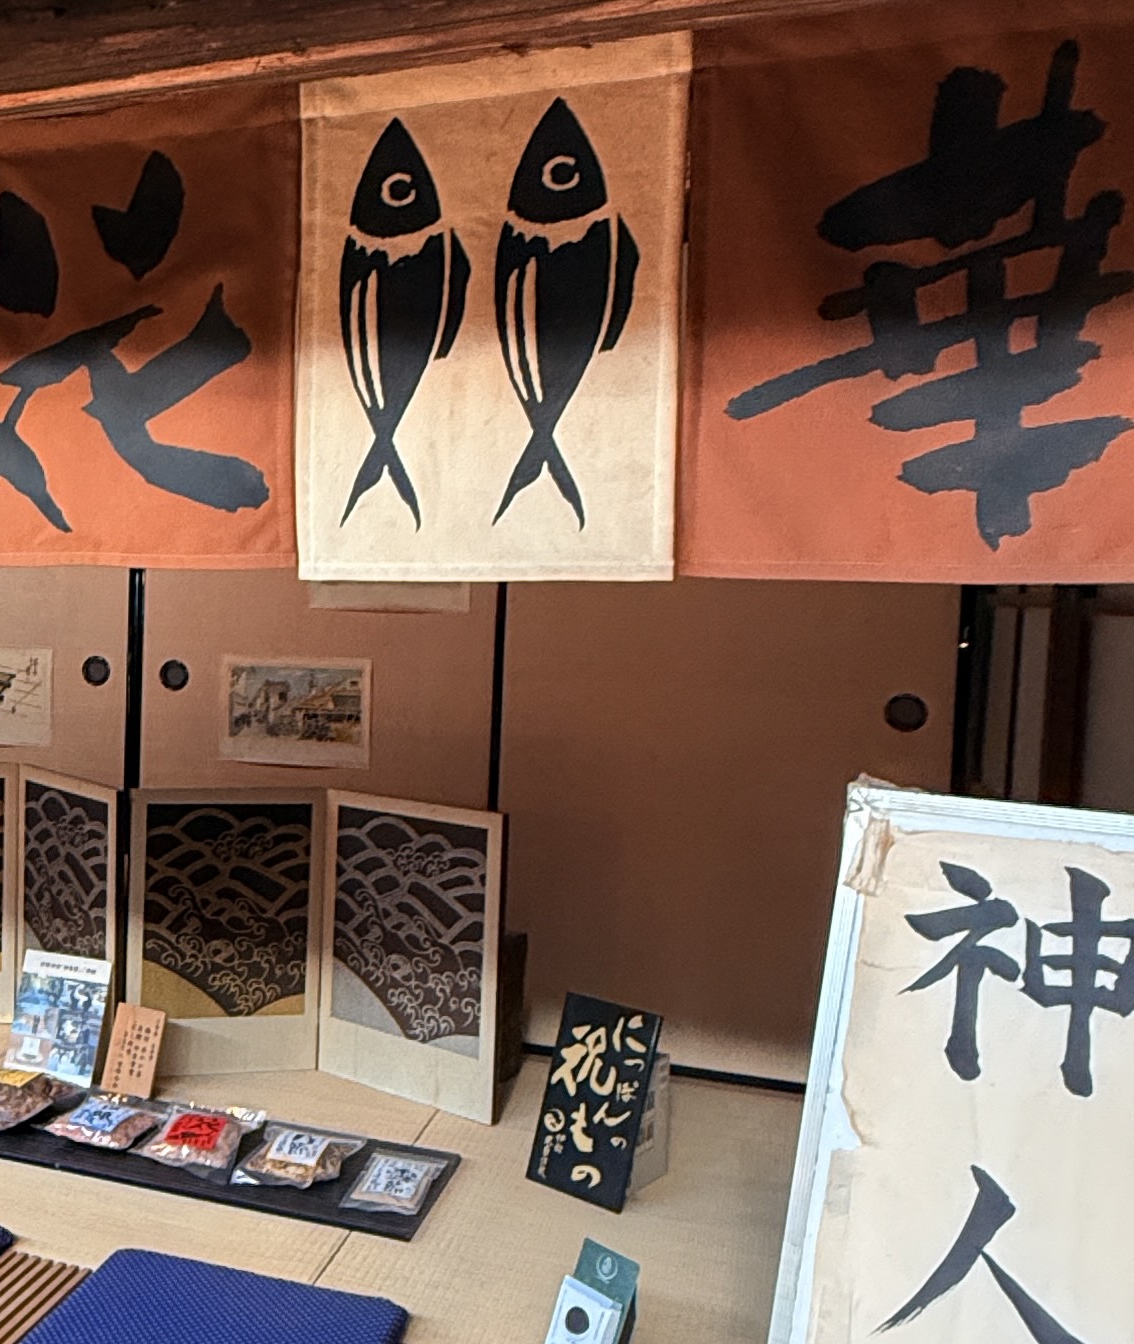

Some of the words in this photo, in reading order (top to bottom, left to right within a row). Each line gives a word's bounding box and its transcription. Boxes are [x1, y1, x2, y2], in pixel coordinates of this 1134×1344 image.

[551, 1024, 616, 1189] 祝もの
[592, 1014, 647, 1150] にっぽんの
